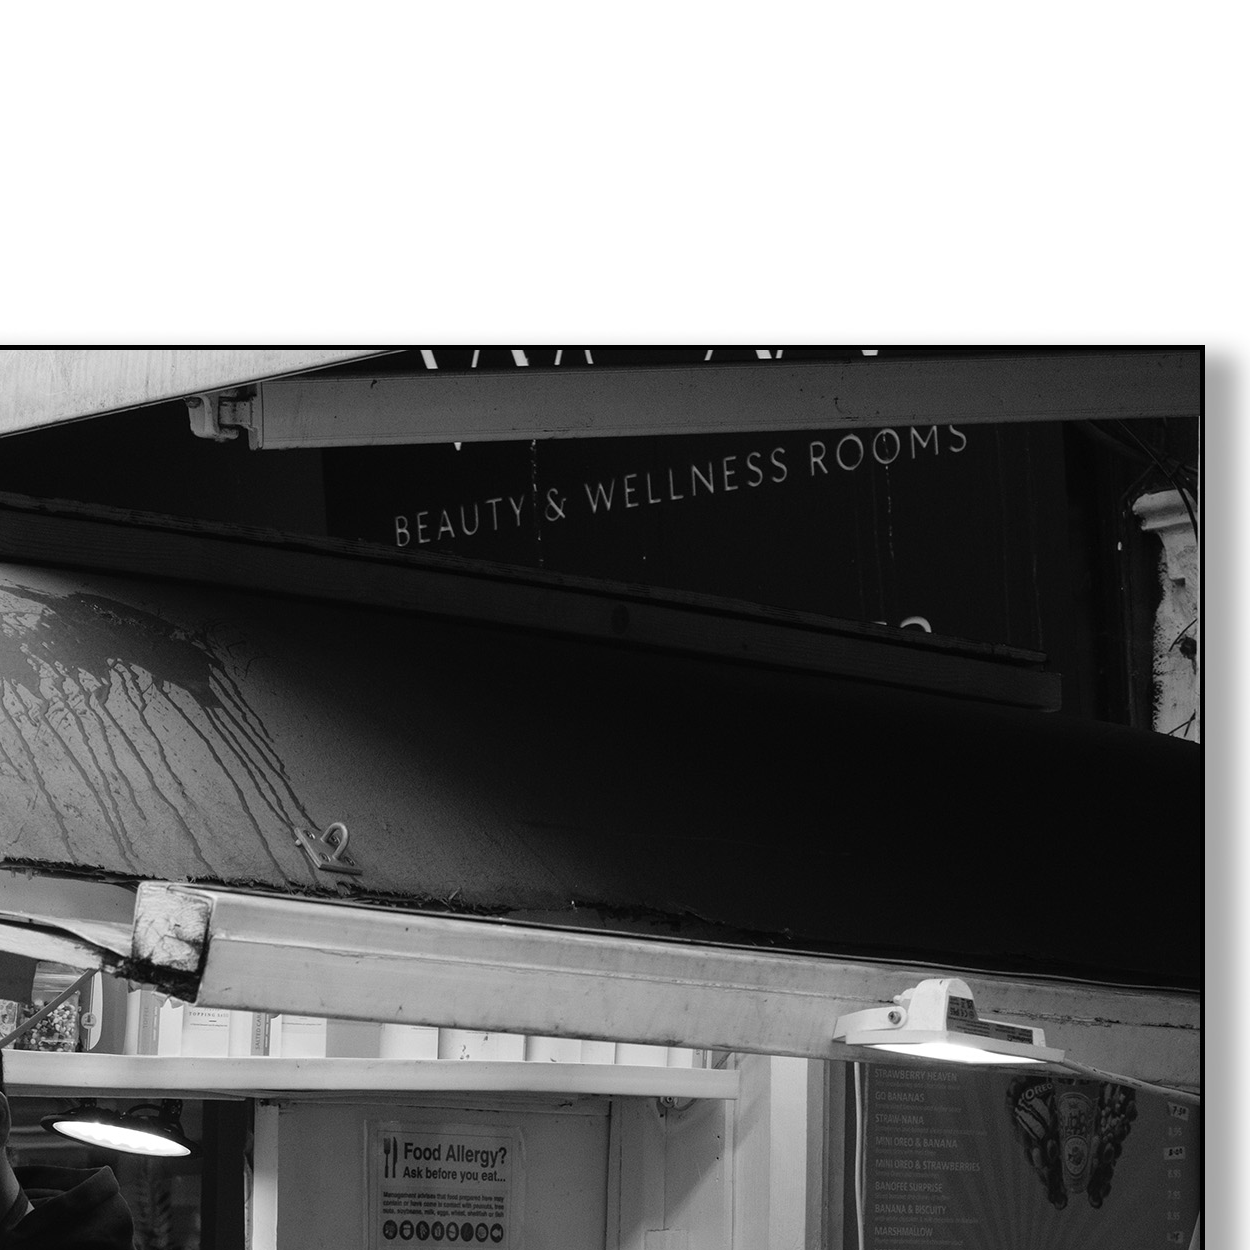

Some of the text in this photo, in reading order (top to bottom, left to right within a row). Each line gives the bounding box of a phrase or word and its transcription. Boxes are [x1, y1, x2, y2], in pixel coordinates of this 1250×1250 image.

[393, 424, 969, 548] BEAUTY & WELLNESS ROOMS
[875, 1068, 958, 1082] STRAWBERRY HEAVEN
[1024, 1081, 1054, 1100] OREO
[888, 1092, 925, 1102] BANANAS
[875, 1113, 924, 1125] STRAW-NANA
[876, 1136, 893, 1147] MINI
[893, 1137, 914, 1147] OREO
[923, 1138, 958, 1148] BANANA
[404, 1142, 507, 1168] Food Allergy?
[876, 1159, 893, 1169] MINI
[894, 1159, 914, 1170] OREO
[922, 1161, 981, 1172] STRAWBERRIES
[403, 1166, 506, 1183] Ask before you eat...
[875, 1181, 943, 1193] BANOFEE SURPRISE
[383, 1191, 417, 1201] Management
[383, 1199, 403, 1207] contain
[875, 1204, 907, 1215] BANANA
[915, 1205, 947, 1215] BISCUITY
[874, 1226, 934, 1237] MARSHMALLOW
